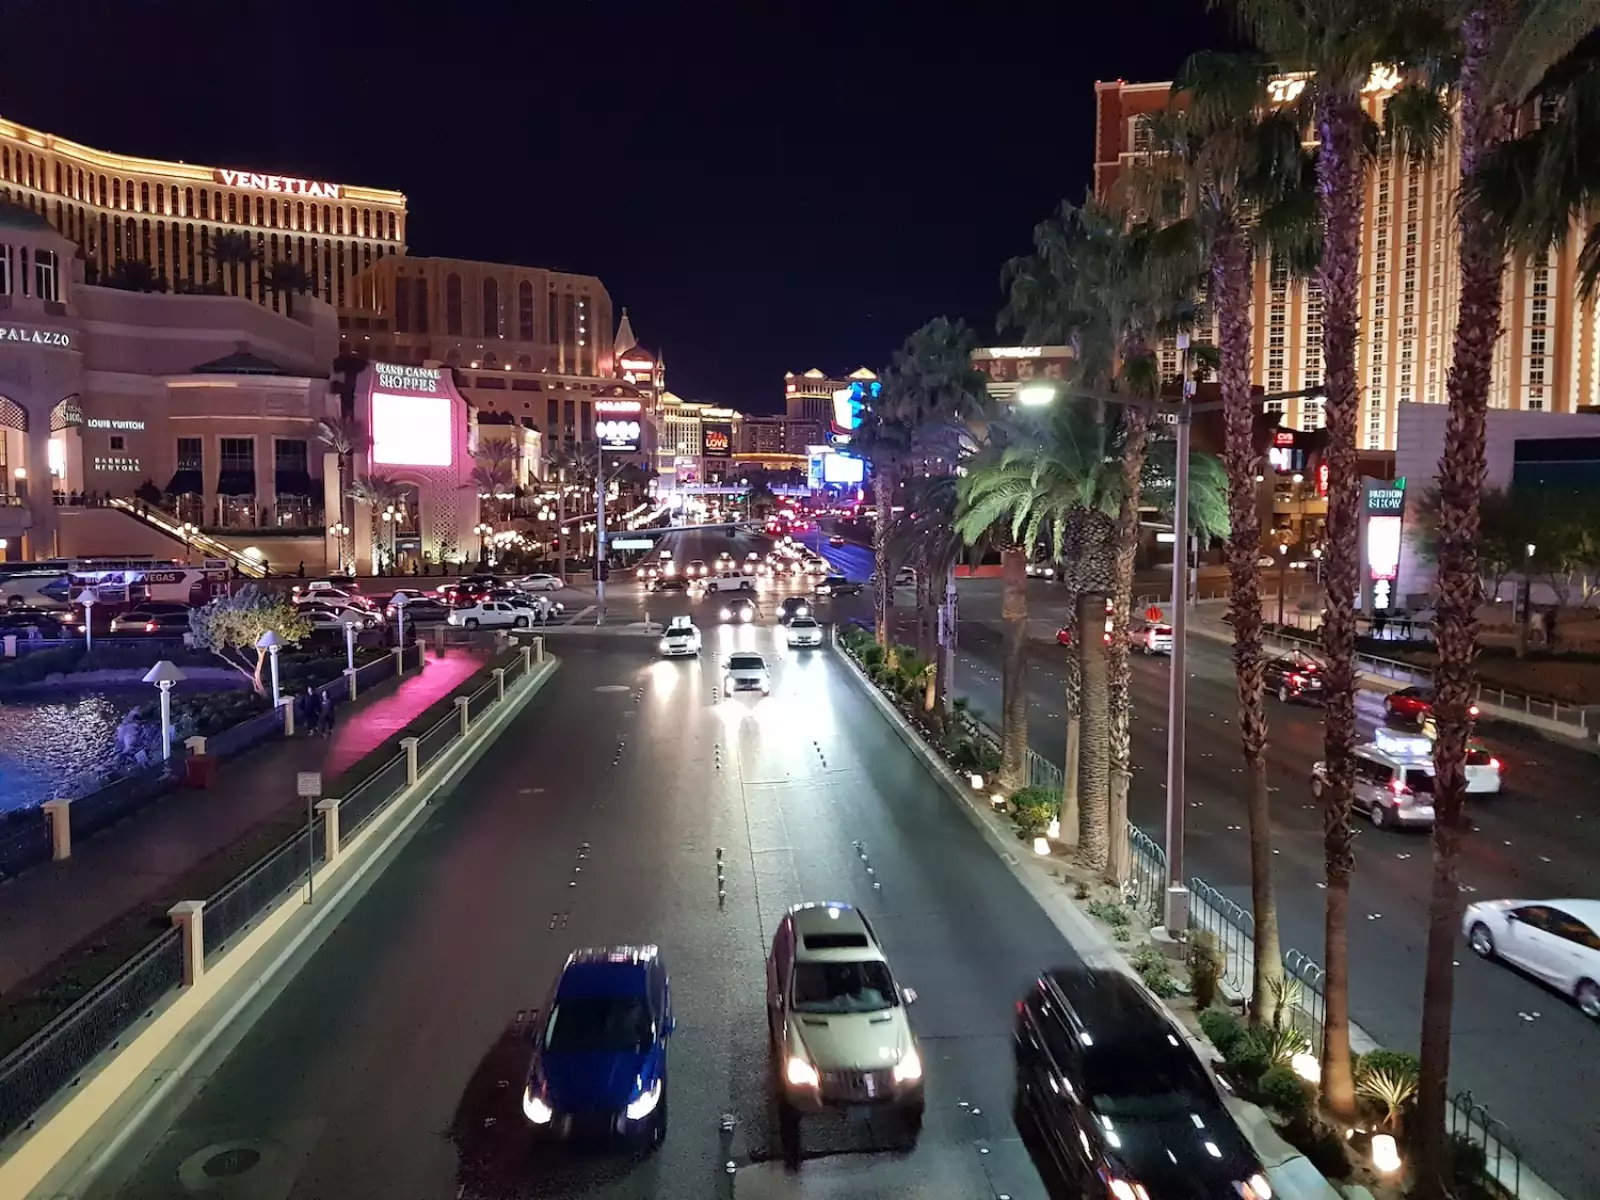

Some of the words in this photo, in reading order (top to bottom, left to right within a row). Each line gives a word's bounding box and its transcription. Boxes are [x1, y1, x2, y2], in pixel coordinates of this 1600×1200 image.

[220, 169, 340, 199] VENETIAN
[0, 328, 70, 347] PALAZZO
[375, 362, 404, 376] GRAND
[405, 367, 441, 380] CANAL
[380, 374, 436, 392] SHOPPES
[87, 419, 110, 429] LOUIS
[112, 420, 145, 430] VUITTON
[705, 439, 728, 448] LOVE
[1369, 489, 1403, 498] FASHION
[1369, 498, 1401, 508] SHOW
[143, 573, 176, 582] VEGAS
